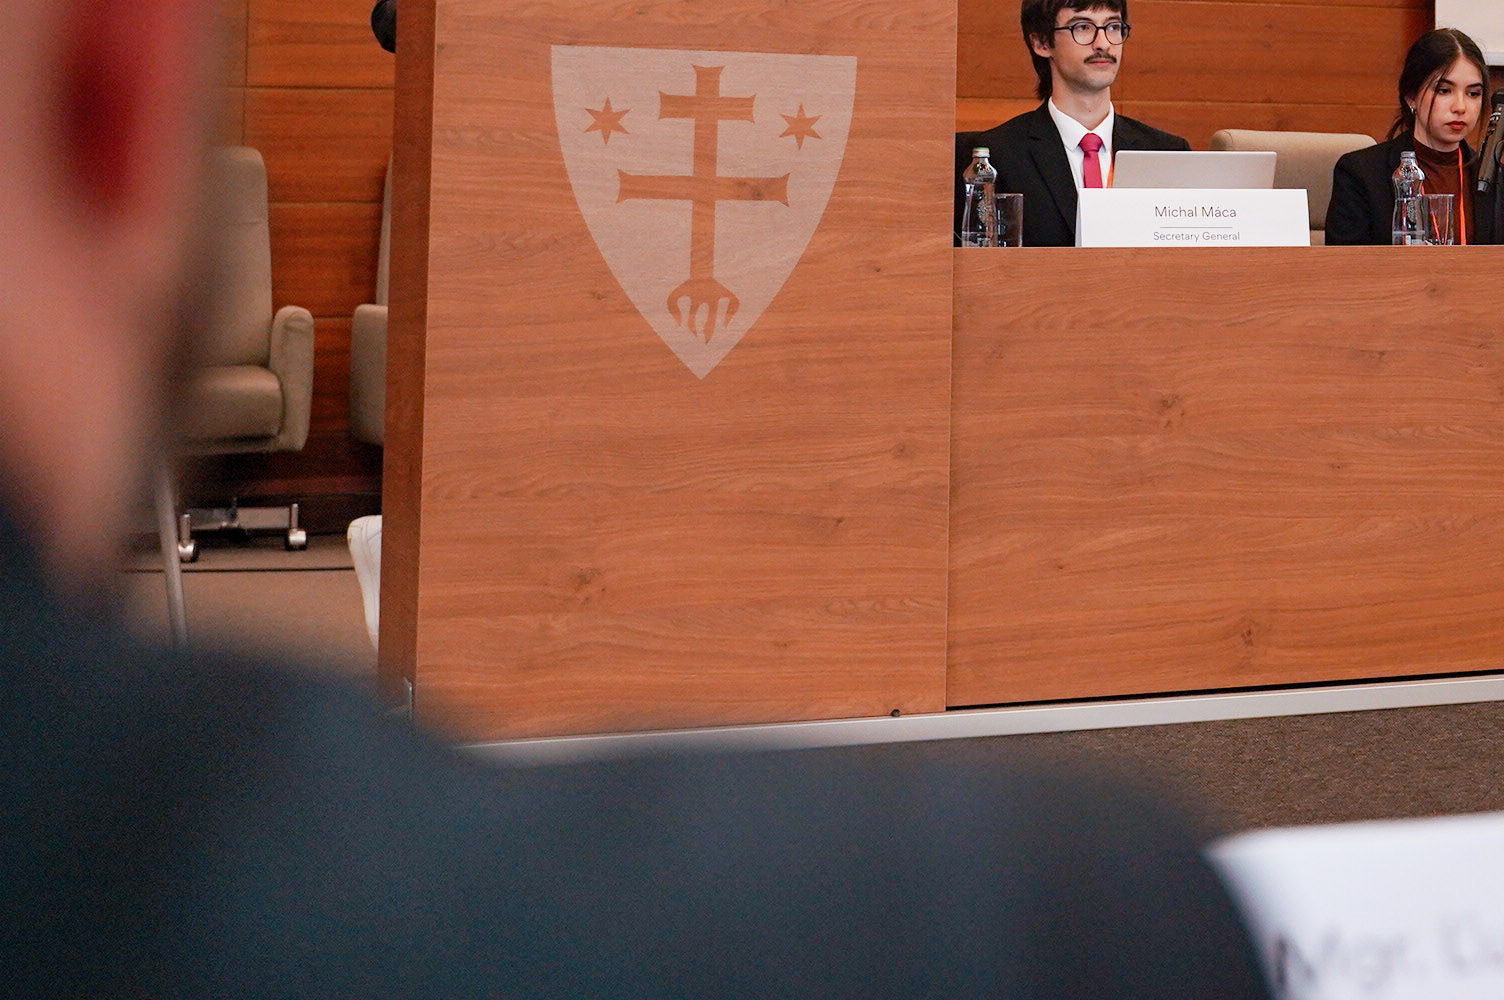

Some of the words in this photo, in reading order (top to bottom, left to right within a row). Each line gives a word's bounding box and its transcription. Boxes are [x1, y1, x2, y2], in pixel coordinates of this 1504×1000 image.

[1154, 205, 1198, 218] Michal
[1201, 205, 1237, 218] Máca
[1153, 231, 1200, 243] Secretary
[1202, 231, 1240, 241] General
